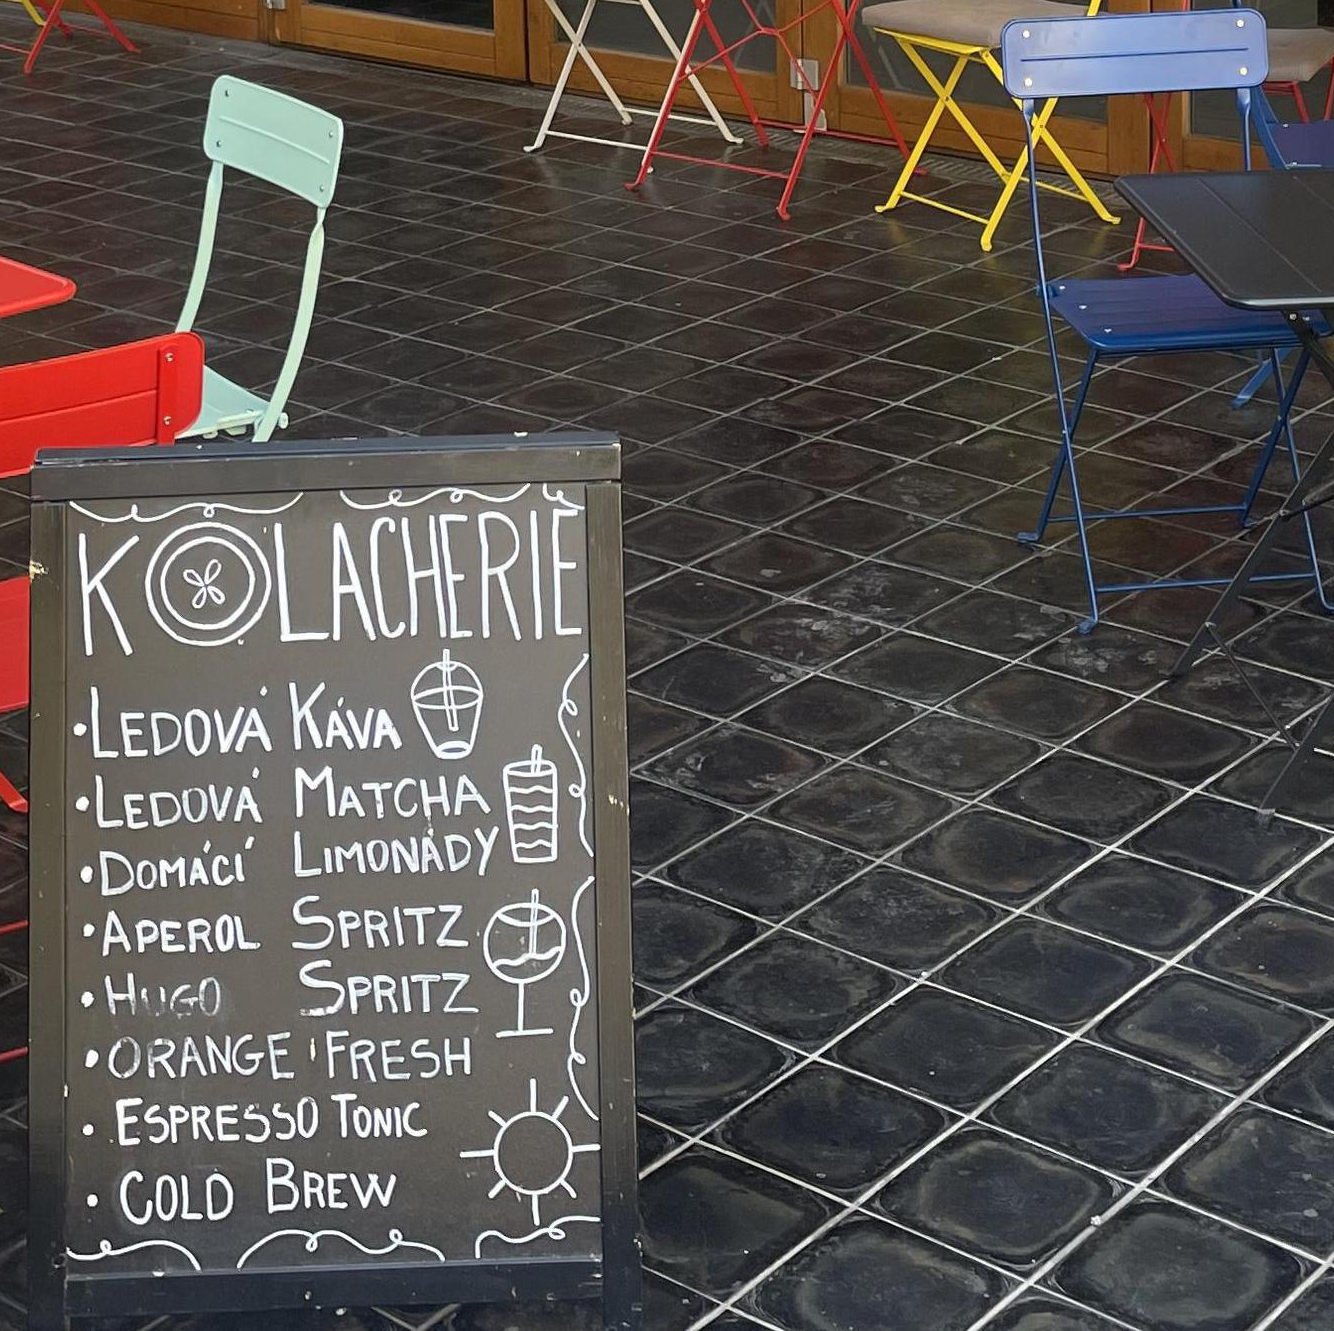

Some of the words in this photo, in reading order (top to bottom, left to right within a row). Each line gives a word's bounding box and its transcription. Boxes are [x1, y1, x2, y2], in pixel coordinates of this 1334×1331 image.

[78, 508, 583, 657] KOLACHERIE
[90, 685, 273, 759] LEDOVÁ
[289, 681, 403, 752] KÁVA
[96, 767, 263, 829] LEDOVÁ
[295, 766, 491, 819] MATCHA
[294, 824, 499, 878] LIMONÁDY
[102, 910, 261, 957] APEROL
[292, 896, 469, 951] SPRITZ
[104, 972, 222, 1019] HUGO
[298, 959, 479, 1018] SPRITZ
[107, 1032, 295, 1080] ORANGE
[325, 1030, 471, 1081] FRESH
[115, 1097, 319, 1147] ESPRESSO
[331, 1094, 428, 1140] TONIC
[119, 1170, 235, 1225] COLD
[266, 1158, 397, 1215] BREW
